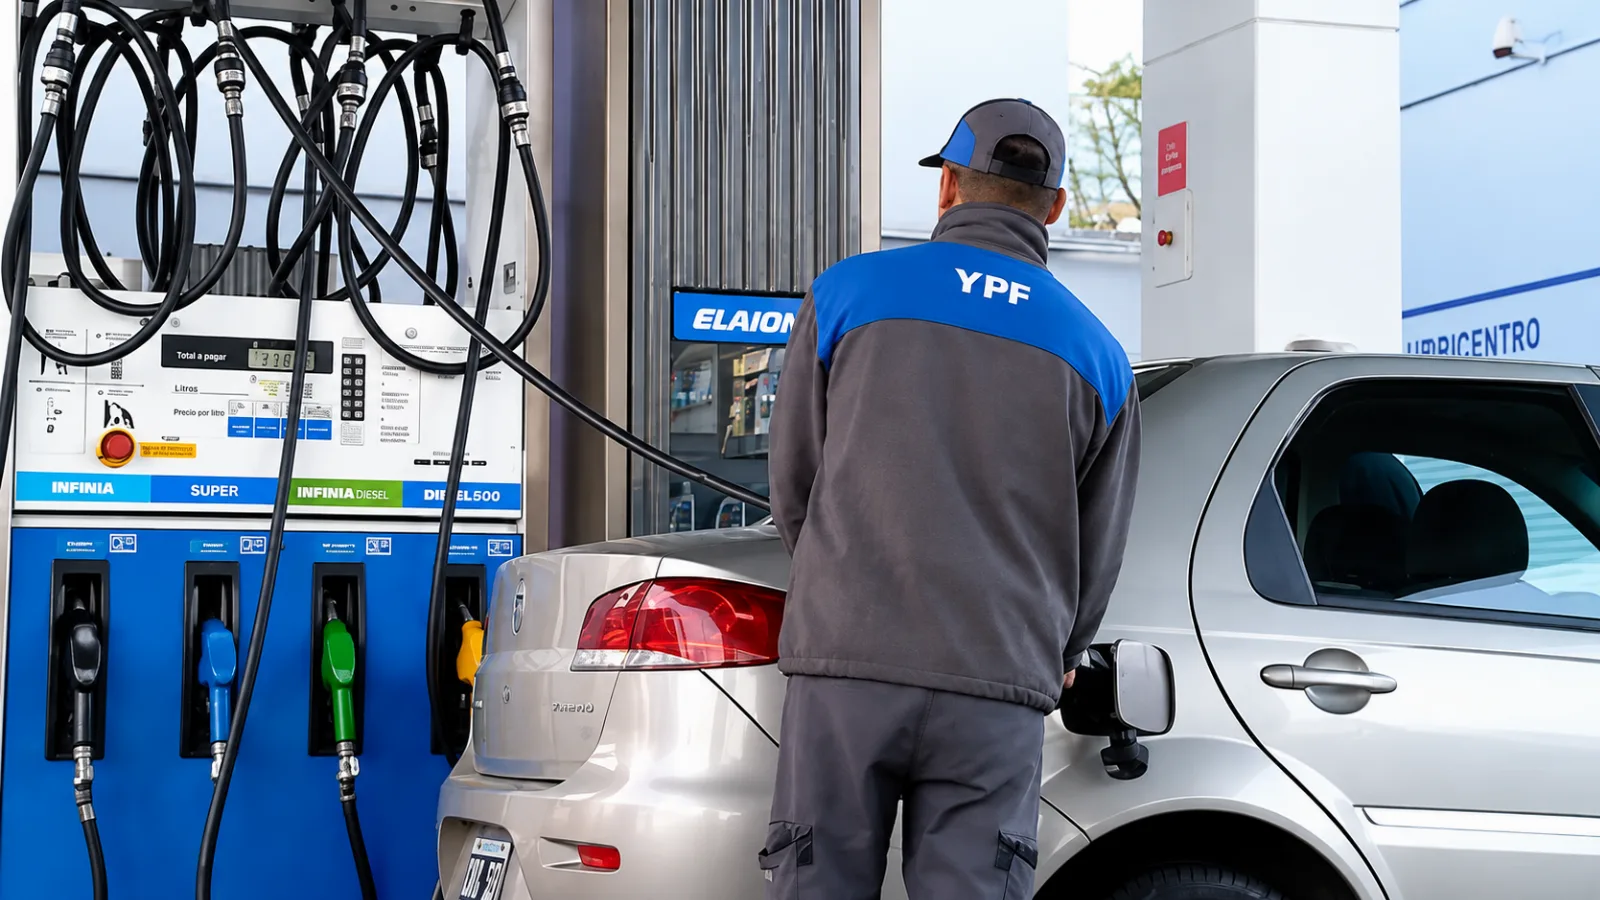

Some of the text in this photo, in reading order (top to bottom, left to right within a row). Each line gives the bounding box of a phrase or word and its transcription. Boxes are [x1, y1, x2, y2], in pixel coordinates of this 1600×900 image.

[955, 267, 1031, 305] YPF
[692, 308, 797, 333] ELAION
[176, 351, 196, 360] Total
[203, 353, 227, 363] pagar
[174, 384, 199, 392] Litros
[173, 408, 197, 416] Precio
[52, 481, 114, 494] INFINIA
[190, 484, 239, 497] SUPER
[297, 486, 389, 500] INFINIA DIESEL
[424, 489, 473, 502] DIEEL
